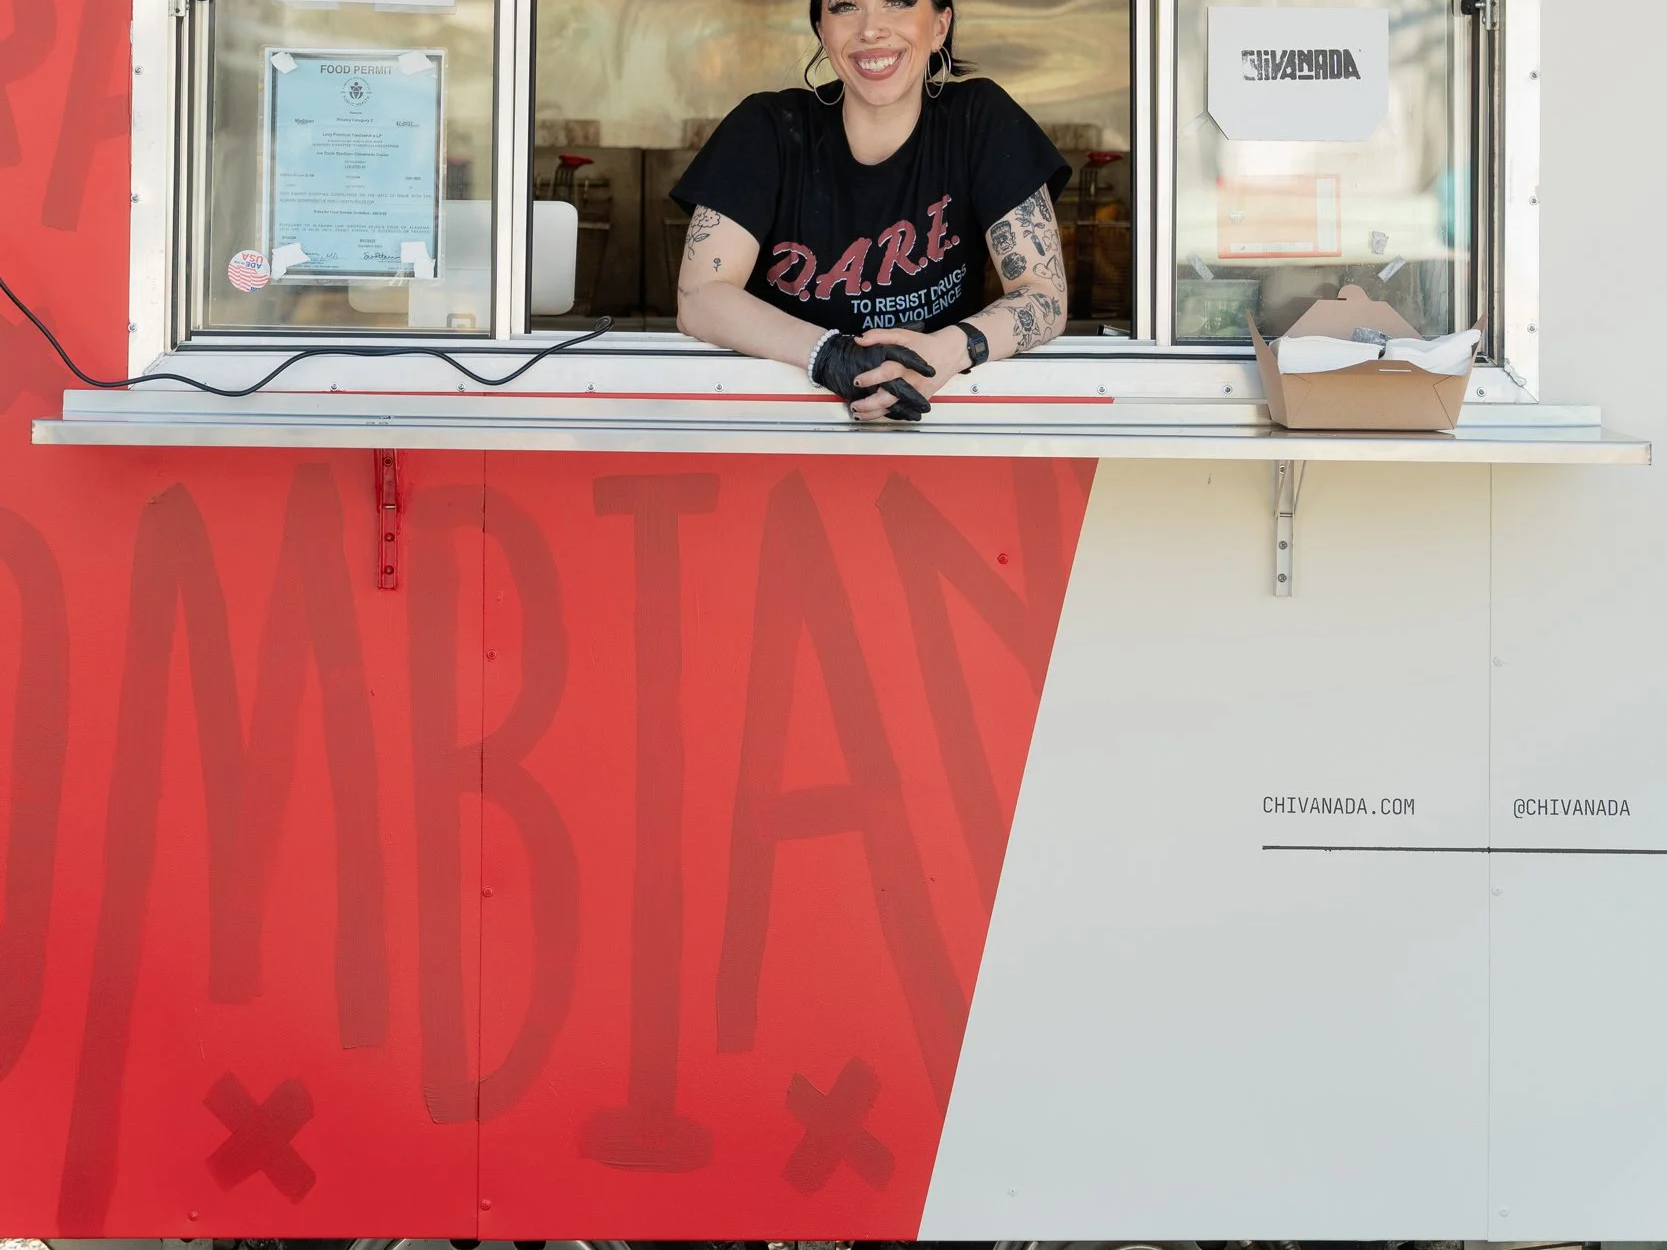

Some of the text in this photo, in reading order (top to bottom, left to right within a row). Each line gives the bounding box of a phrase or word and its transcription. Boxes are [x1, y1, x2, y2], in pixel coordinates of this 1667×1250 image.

[320, 64, 393, 75] FOOD PERMIT
[242, 253, 263, 262] USA
[767, 194, 961, 301] D.A.R.E.
[851, 263, 967, 314] TO RESIST DRUGS
[862, 285, 962, 329] AND VIOLENCE
[1262, 796, 1415, 815] CHIVANADA.COM
[1513, 798, 1631, 819] @CHIVANADA
